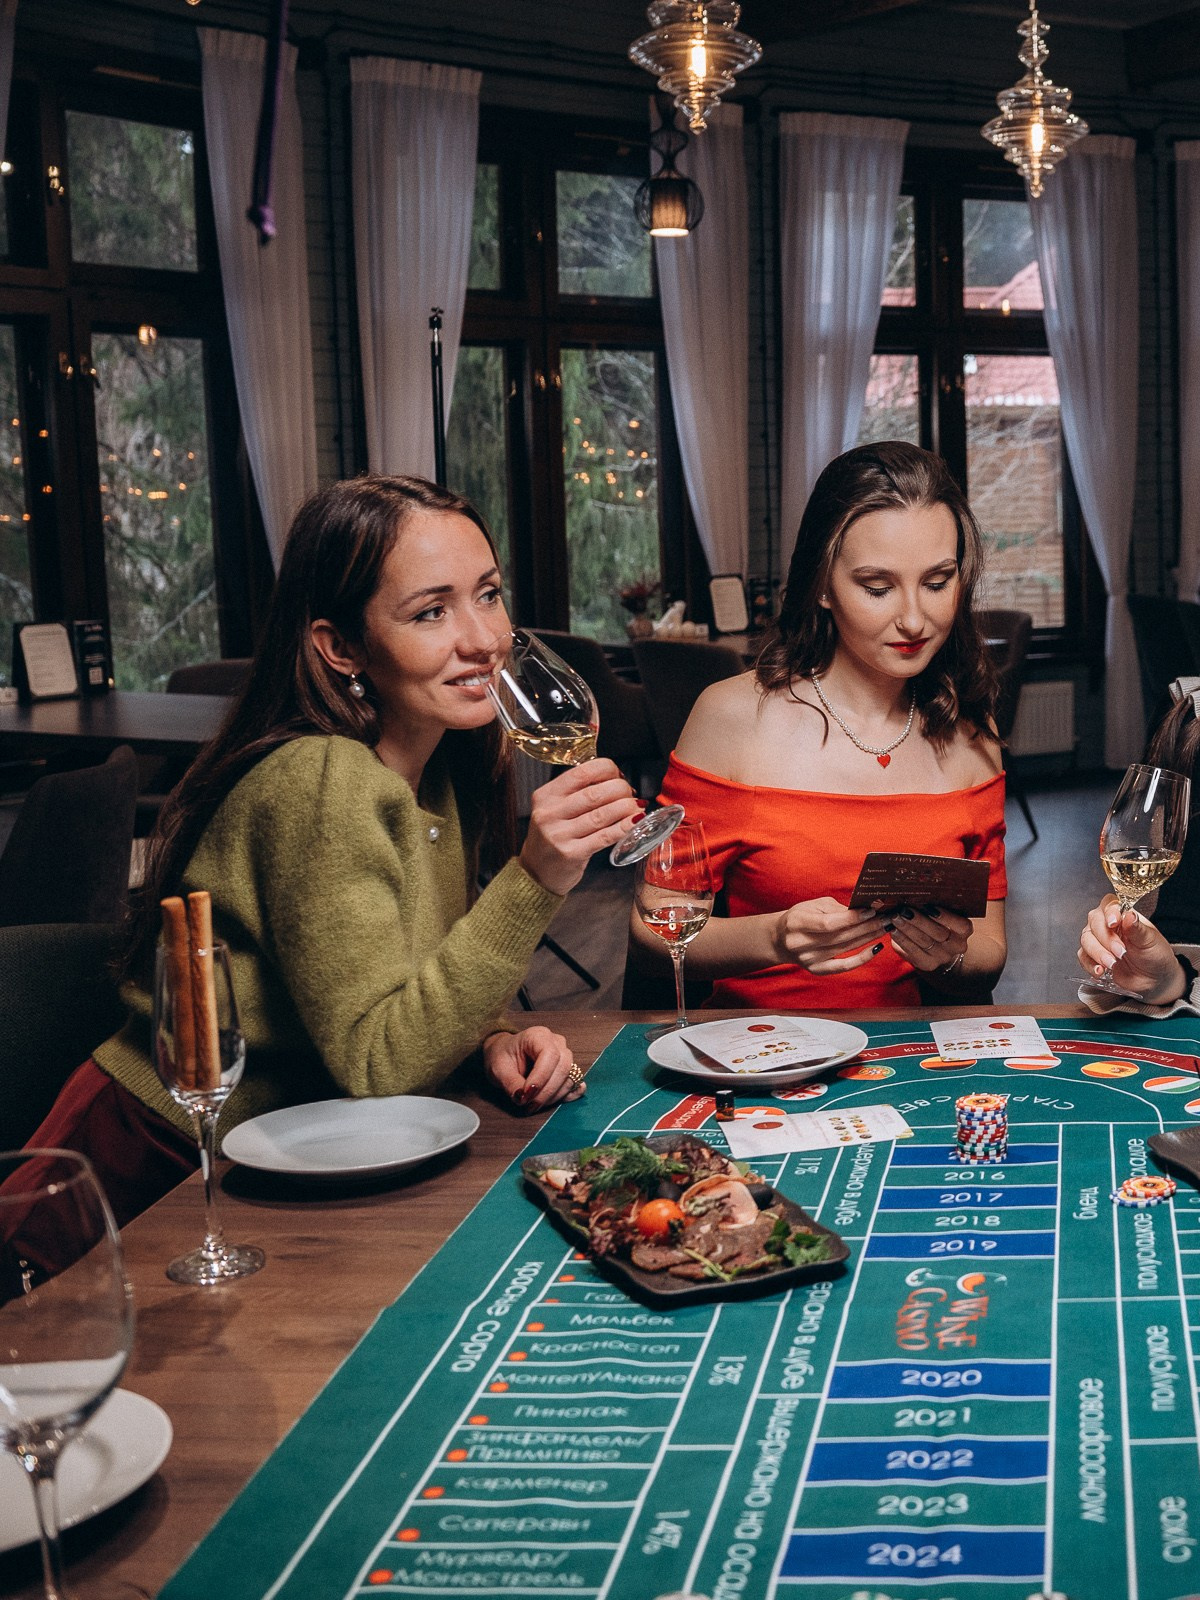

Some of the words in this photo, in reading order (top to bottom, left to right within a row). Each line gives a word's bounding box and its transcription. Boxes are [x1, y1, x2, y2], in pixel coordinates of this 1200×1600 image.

[1112, 1049, 1174, 1063] Испания
[794, 1157, 822, 1175] 11%
[846, 1142, 876, 1191] ыдержано
[944, 1171, 1005, 1181] 2016
[939, 1192, 1003, 1204] 2017
[1073, 1186, 1099, 1220] бленд
[834, 1199, 861, 1226] дубе
[935, 1215, 1001, 1227] 2018
[929, 1239, 998, 1253] 2019
[1133, 1213, 1163, 1290] полусладкое
[797, 1281, 833, 1334] ержано
[896, 1287, 947, 1350] CASINO
[569, 1314, 675, 1327] Мальбек
[935, 1296, 989, 1350] WINE
[451, 1320, 500, 1373] сорта
[529, 1339, 680, 1355] Красностоп
[793, 1335, 816, 1346] в
[493, 1371, 687, 1386] Монтепульчано
[708, 1355, 748, 1386] 13%
[780, 1346, 814, 1390] дубе
[901, 1369, 982, 1388] 2020
[1145, 1324, 1181, 1411] полусухое
[513, 1403, 630, 1418] Пинотаж
[894, 1406, 971, 1428] 2021
[466, 1445, 621, 1462] Примитиво
[744, 1398, 800, 1508] выдержано
[885, 1449, 974, 1471] 2022
[1079, 1377, 1113, 1524] моносортовое
[454, 1476, 609, 1492] Карменер
[876, 1493, 970, 1517] 2023
[438, 1514, 592, 1533] Саперави
[641, 1509, 691, 1555] 14%
[734, 1510, 767, 1540] на
[1158, 1496, 1198, 1564] сухое
[866, 1542, 963, 1568] 2024
[710, 1543, 757, 1600] осад
